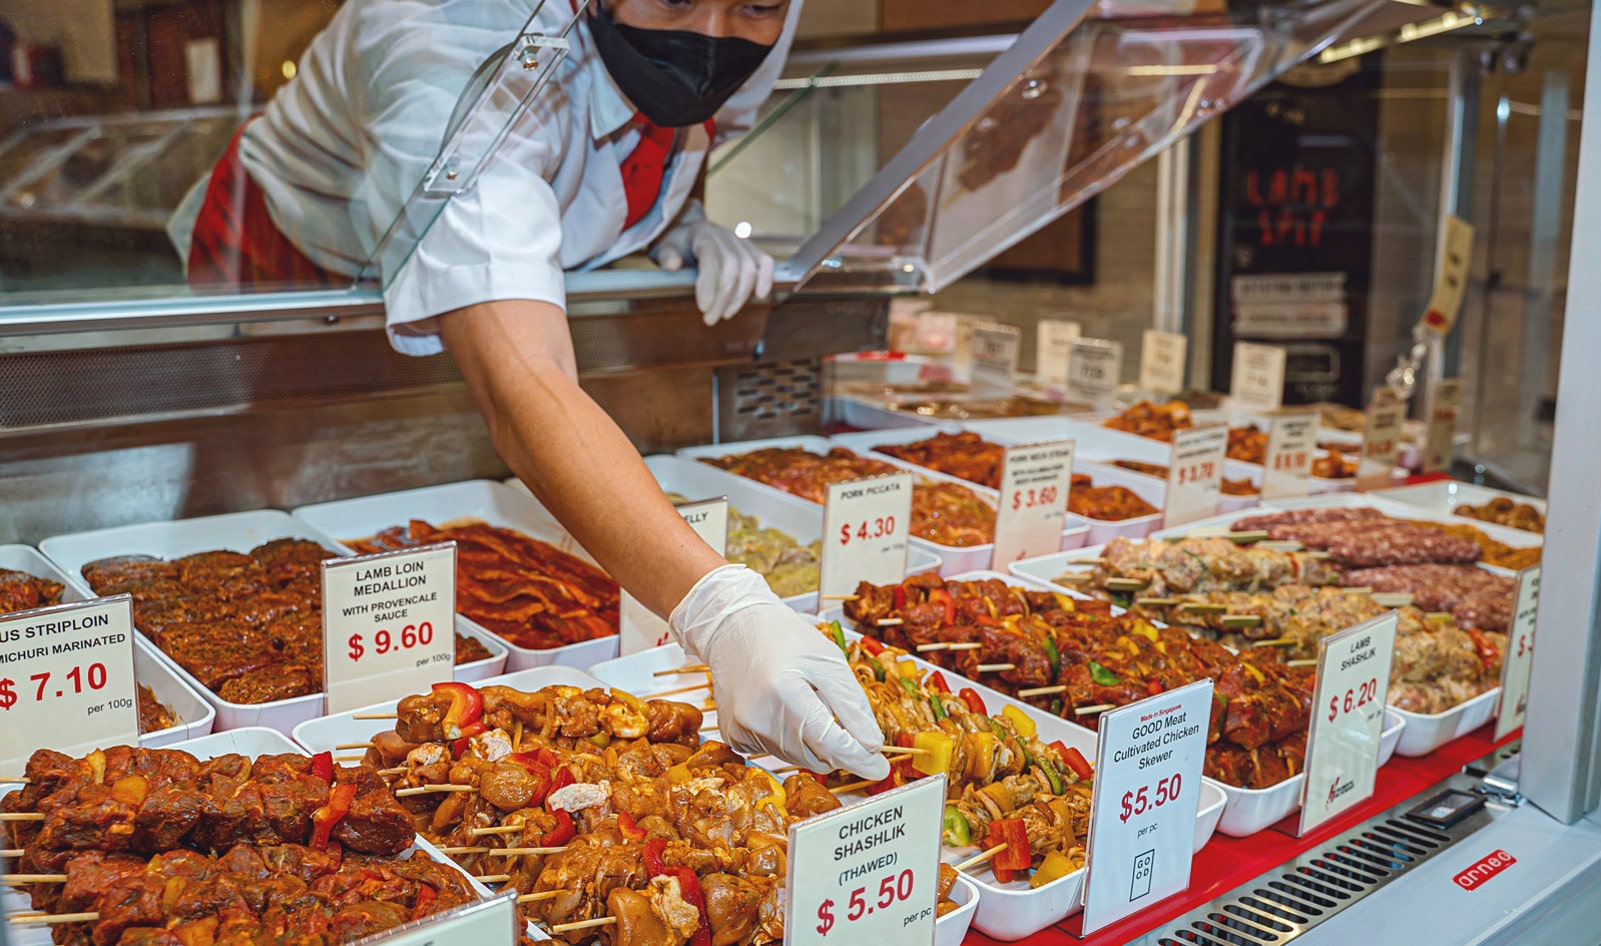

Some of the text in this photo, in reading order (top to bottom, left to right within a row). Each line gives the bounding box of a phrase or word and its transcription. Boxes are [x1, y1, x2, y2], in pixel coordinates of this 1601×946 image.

[840, 490, 863, 500] PORK
[1012, 485, 1057, 511] $ 3.60
[840, 515, 895, 546] $ 4.30
[356, 560, 424, 582] LAMB LOIN
[354, 575, 426, 597] MEDALLION
[342, 592, 437, 617] WITH PROVENCALE
[374, 609, 408, 623] SAUCE
[25, 614, 109, 638] STRIPLOIN
[52, 633, 126, 655] MARINATED
[348, 621, 433, 662] $ 9.60
[1350, 636, 1371, 653] LAMB
[416, 653, 451, 667] per 100g
[1340, 647, 1376, 671] SHASHLIK
[0, 662, 107, 710] $ 7.10
[87, 699, 133, 716] per 100g
[1328, 677, 1377, 724] $ 6.20
[1140, 713, 1153, 722] Made
[1159, 704, 1182, 716] Singapore
[1132, 711, 1187, 740] GOOD Meat
[1113, 724, 1199, 763] Cultivated Chicken
[1138, 749, 1173, 770] Skewer
[1119, 773, 1182, 824] $5.50
[839, 805, 903, 840] CHICKEN
[1137, 822, 1158, 839] per pc
[834, 823, 906, 861] SHASHLIK
[838, 852, 898, 886] (THAWED)
[816, 868, 914, 936] $ 5.50
[903, 907, 932, 927] per pc
